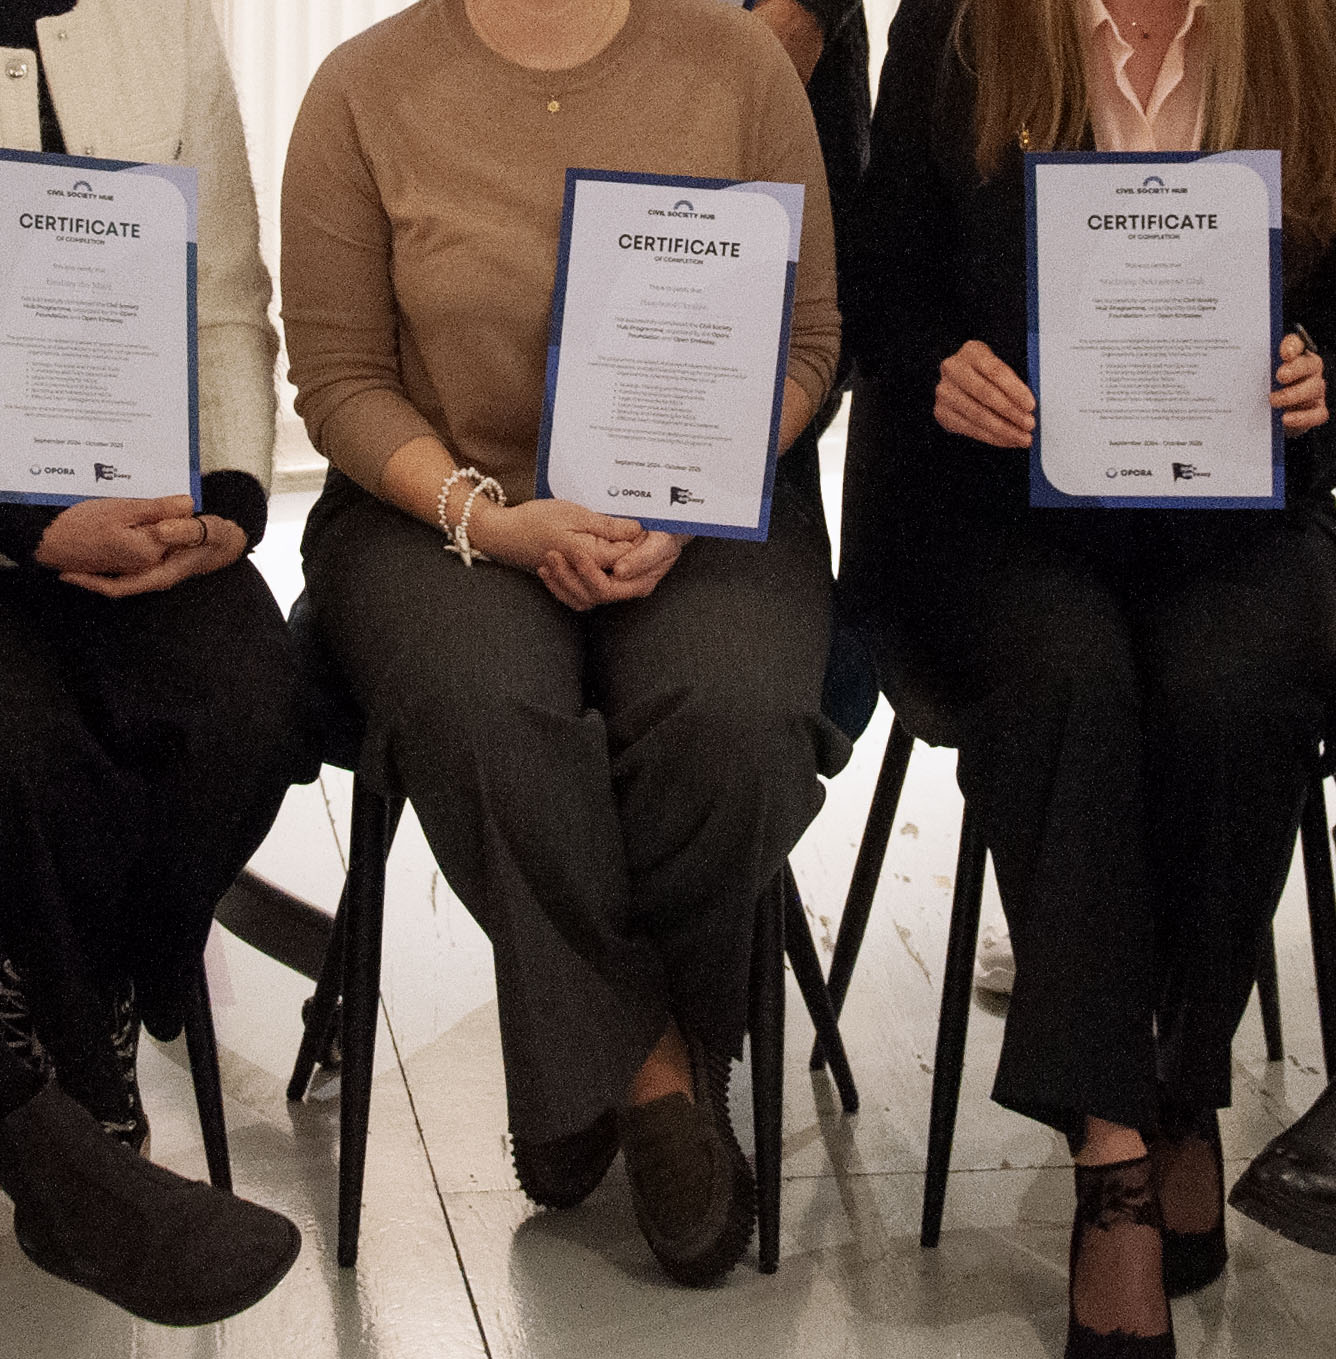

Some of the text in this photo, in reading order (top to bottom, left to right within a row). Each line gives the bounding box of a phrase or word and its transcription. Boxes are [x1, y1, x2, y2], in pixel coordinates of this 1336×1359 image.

[19, 213, 140, 238] CERTIFICATE
[1087, 213, 1217, 230] CERTIFICATE
[618, 233, 740, 257] CERTIFICATE
